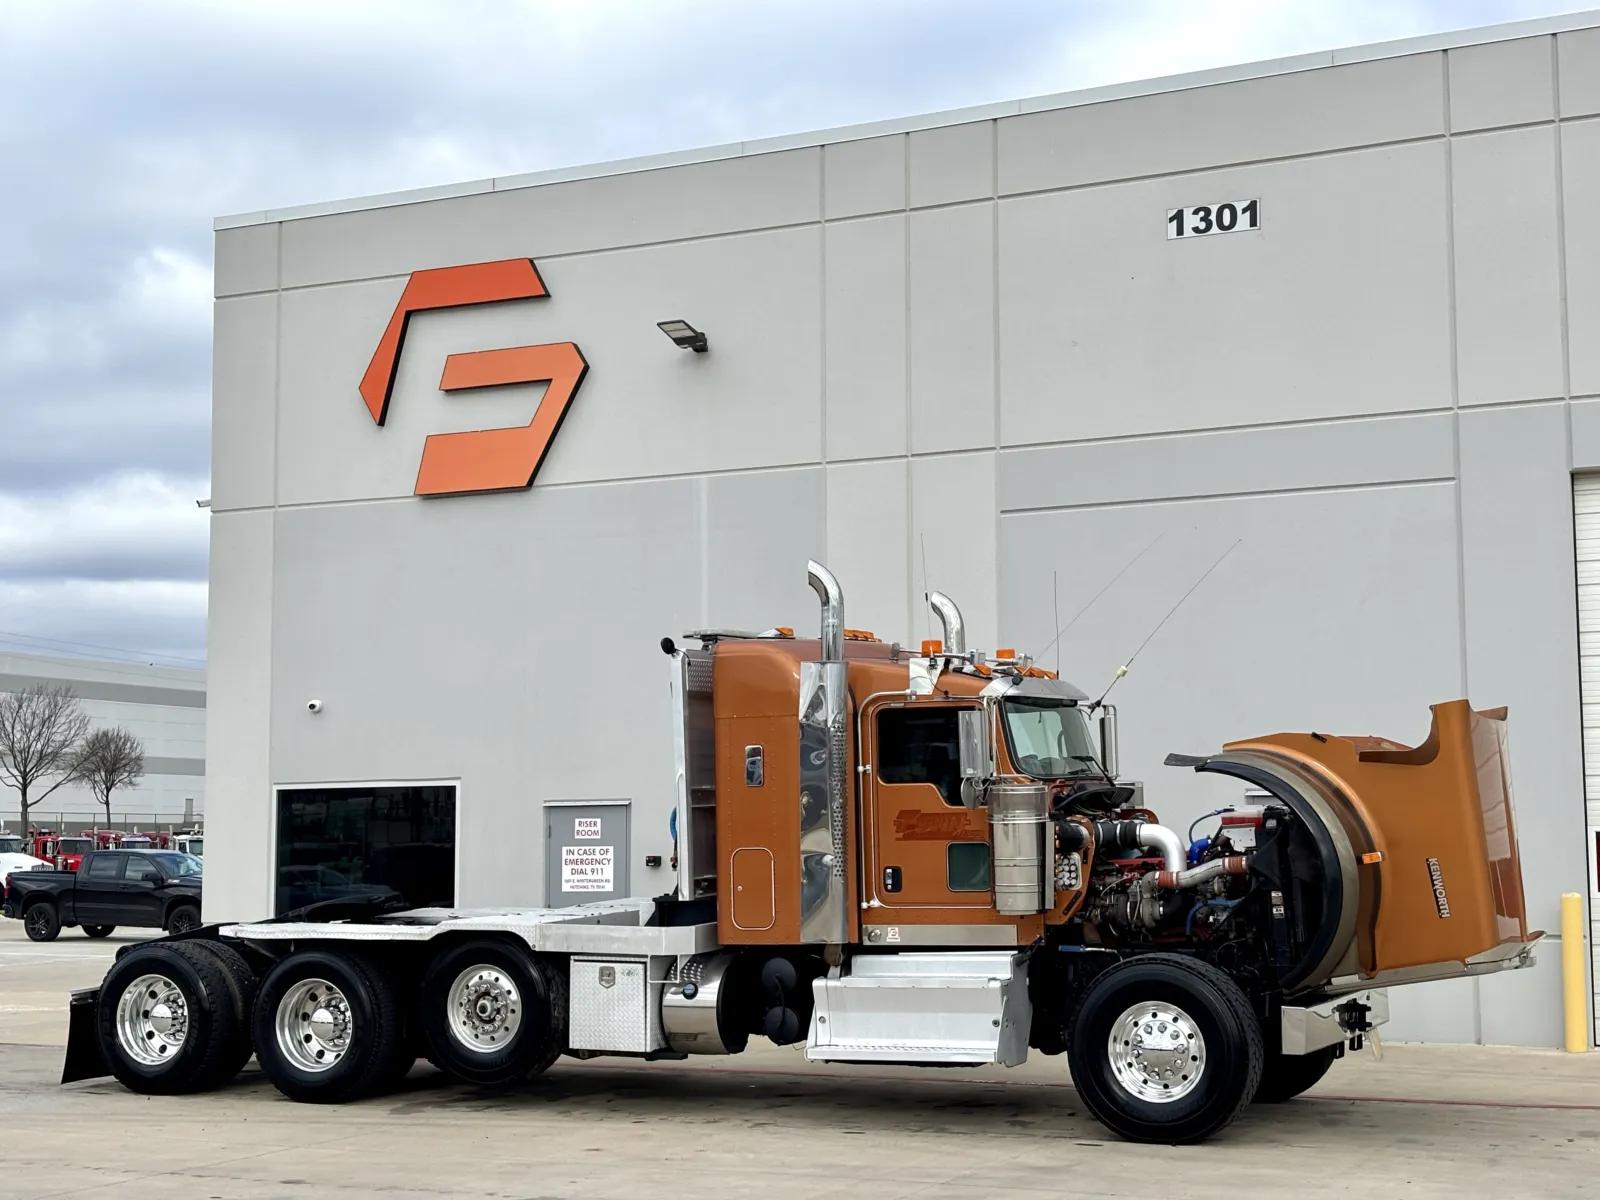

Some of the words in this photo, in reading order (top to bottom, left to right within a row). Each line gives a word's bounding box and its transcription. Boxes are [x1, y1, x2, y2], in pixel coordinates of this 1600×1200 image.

[1168, 199, 1258, 237] 1301
[578, 820, 598, 828] RISER
[576, 829, 600, 837] ROOM
[566, 848, 575, 856] IN
[577, 848, 597, 856] CASE
[599, 848, 610, 856] OF
[564, 858, 612, 866] EMERGENCY
[570, 867, 588, 876] DIAL
[590, 867, 604, 876] 911
[1427, 857, 1451, 918] KENWORTH
